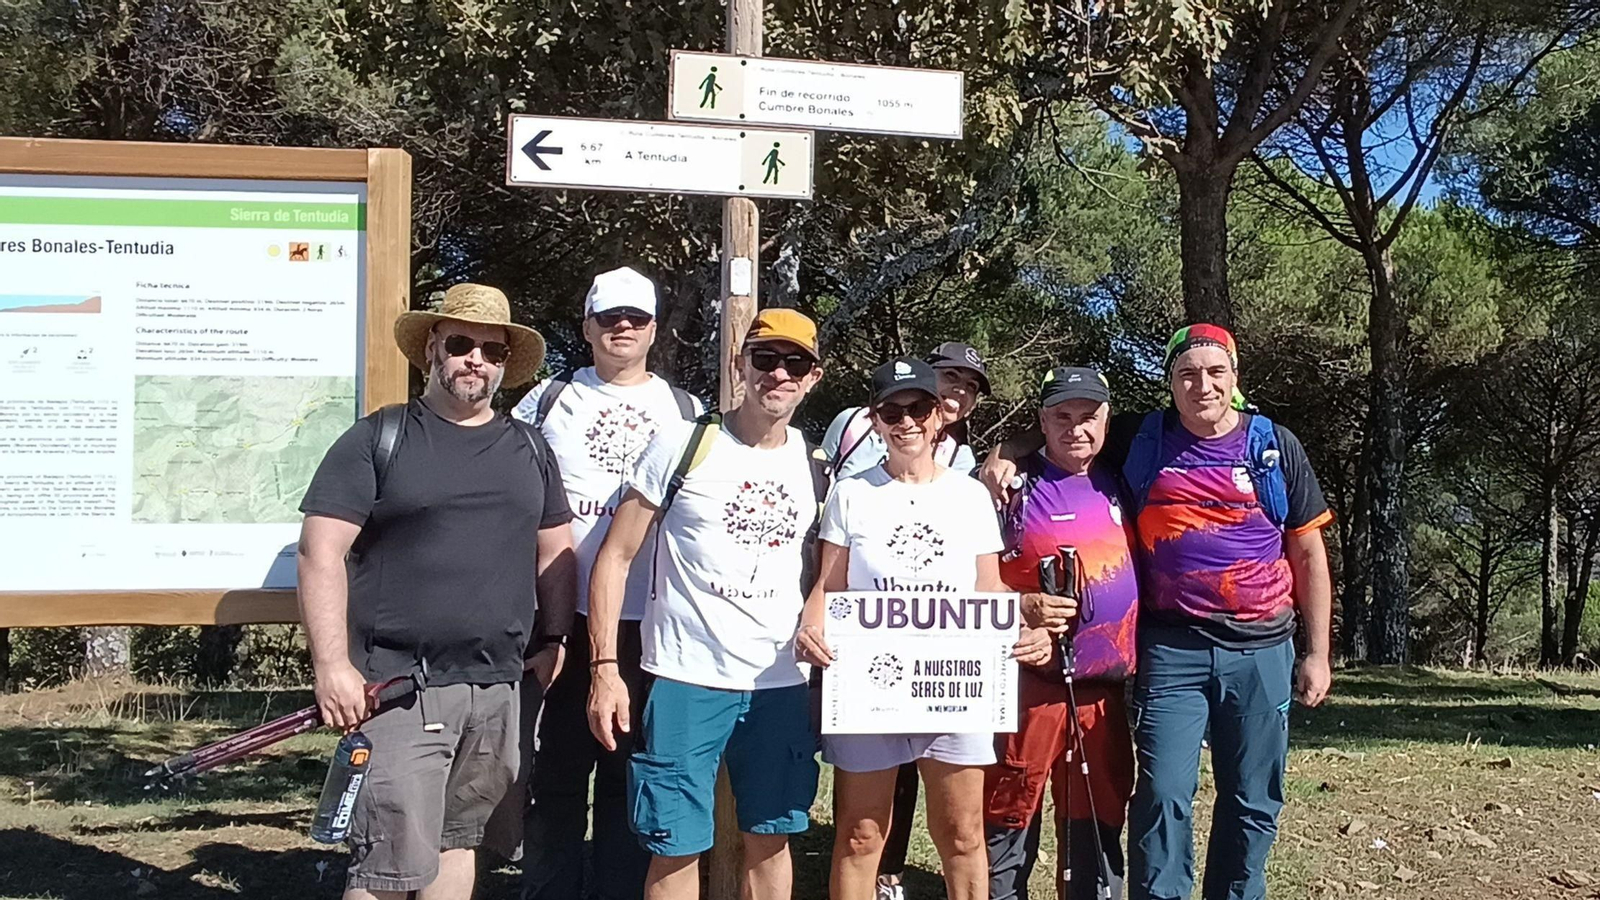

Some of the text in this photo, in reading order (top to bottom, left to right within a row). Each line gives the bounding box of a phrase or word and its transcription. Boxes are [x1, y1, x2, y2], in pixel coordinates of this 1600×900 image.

[759, 87, 851, 102] Fin de recorrido
[758, 101, 854, 117] Cumbre Bonales
[877, 99, 900, 108] 1055
[625, 151, 633, 159] A
[230, 208, 270, 221] Sierra
[273, 209, 290, 222] de
[0, 240, 26, 253] res
[135, 326, 198, 334] Characteristics
[579, 500, 615, 517] Ubu
[857, 597, 1015, 630] UBUNTU
[914, 659, 981, 676] A NUESTROS
[911, 681, 983, 698] SERES DE LUZ
